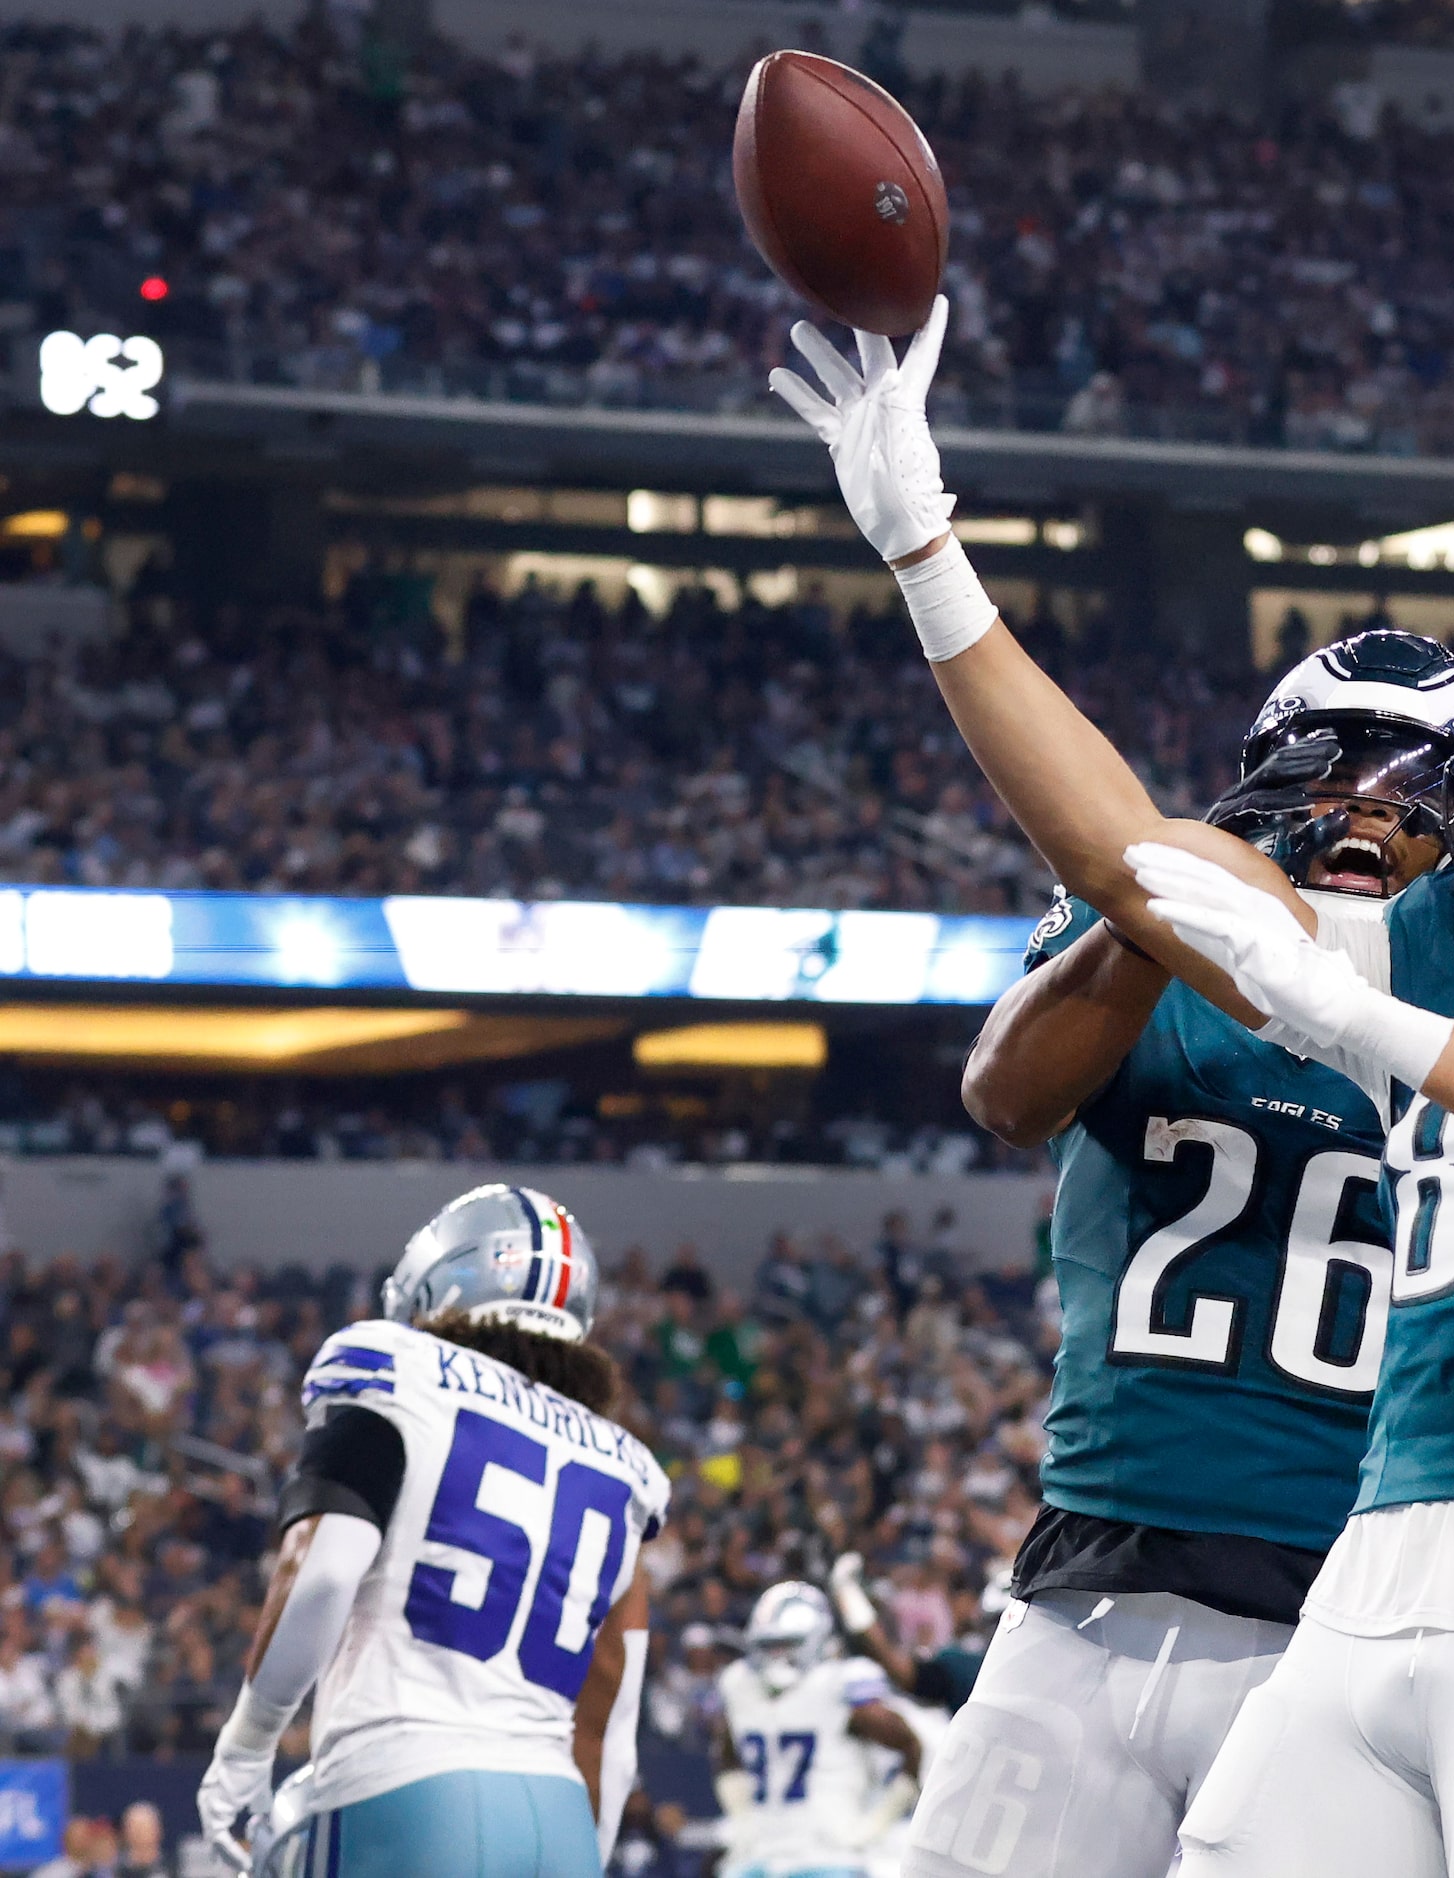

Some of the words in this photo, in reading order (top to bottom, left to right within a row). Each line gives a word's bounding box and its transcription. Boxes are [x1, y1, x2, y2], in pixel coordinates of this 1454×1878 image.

[1111, 1115, 1395, 1393] 26
[402, 1406, 634, 1706] 50
[736, 1731, 817, 1804] 97
[911, 1729, 1043, 1876] 26
